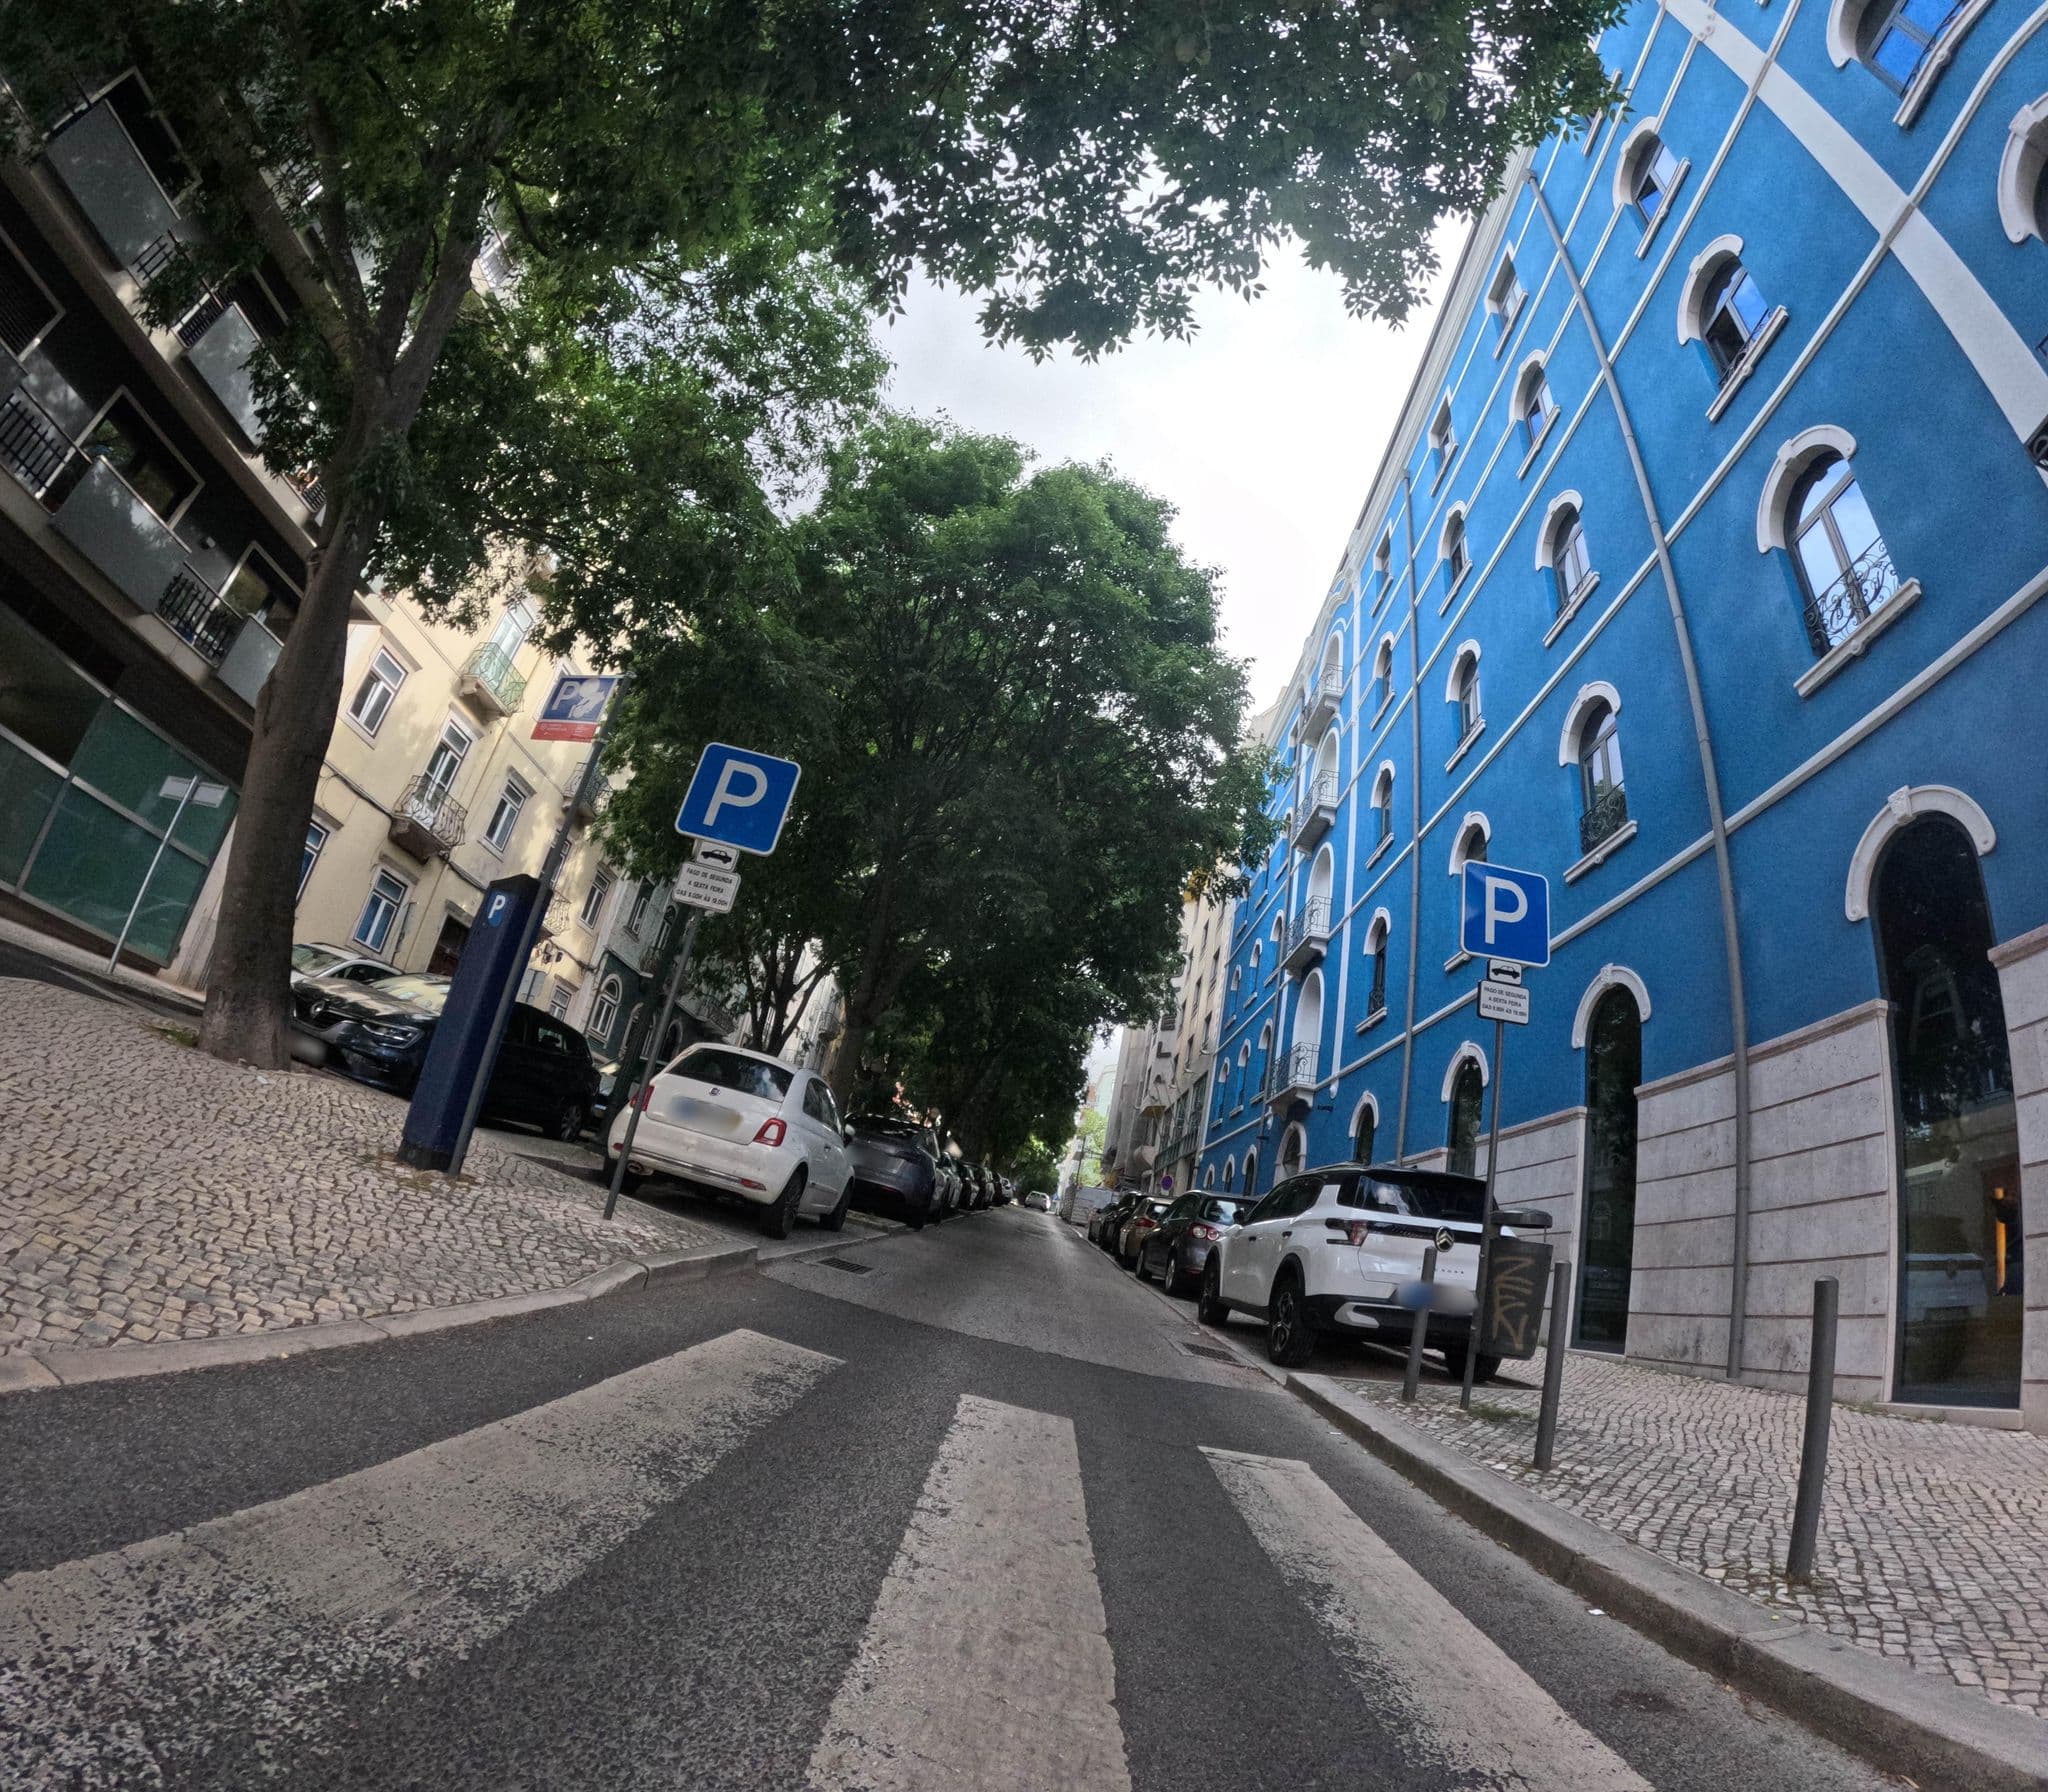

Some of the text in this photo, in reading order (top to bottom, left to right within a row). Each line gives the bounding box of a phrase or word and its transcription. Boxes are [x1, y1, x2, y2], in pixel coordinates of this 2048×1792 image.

[552, 681, 580, 710] P
[703, 759, 768, 827] P
[488, 894, 506, 919] P
[1485, 875, 1529, 945] P
